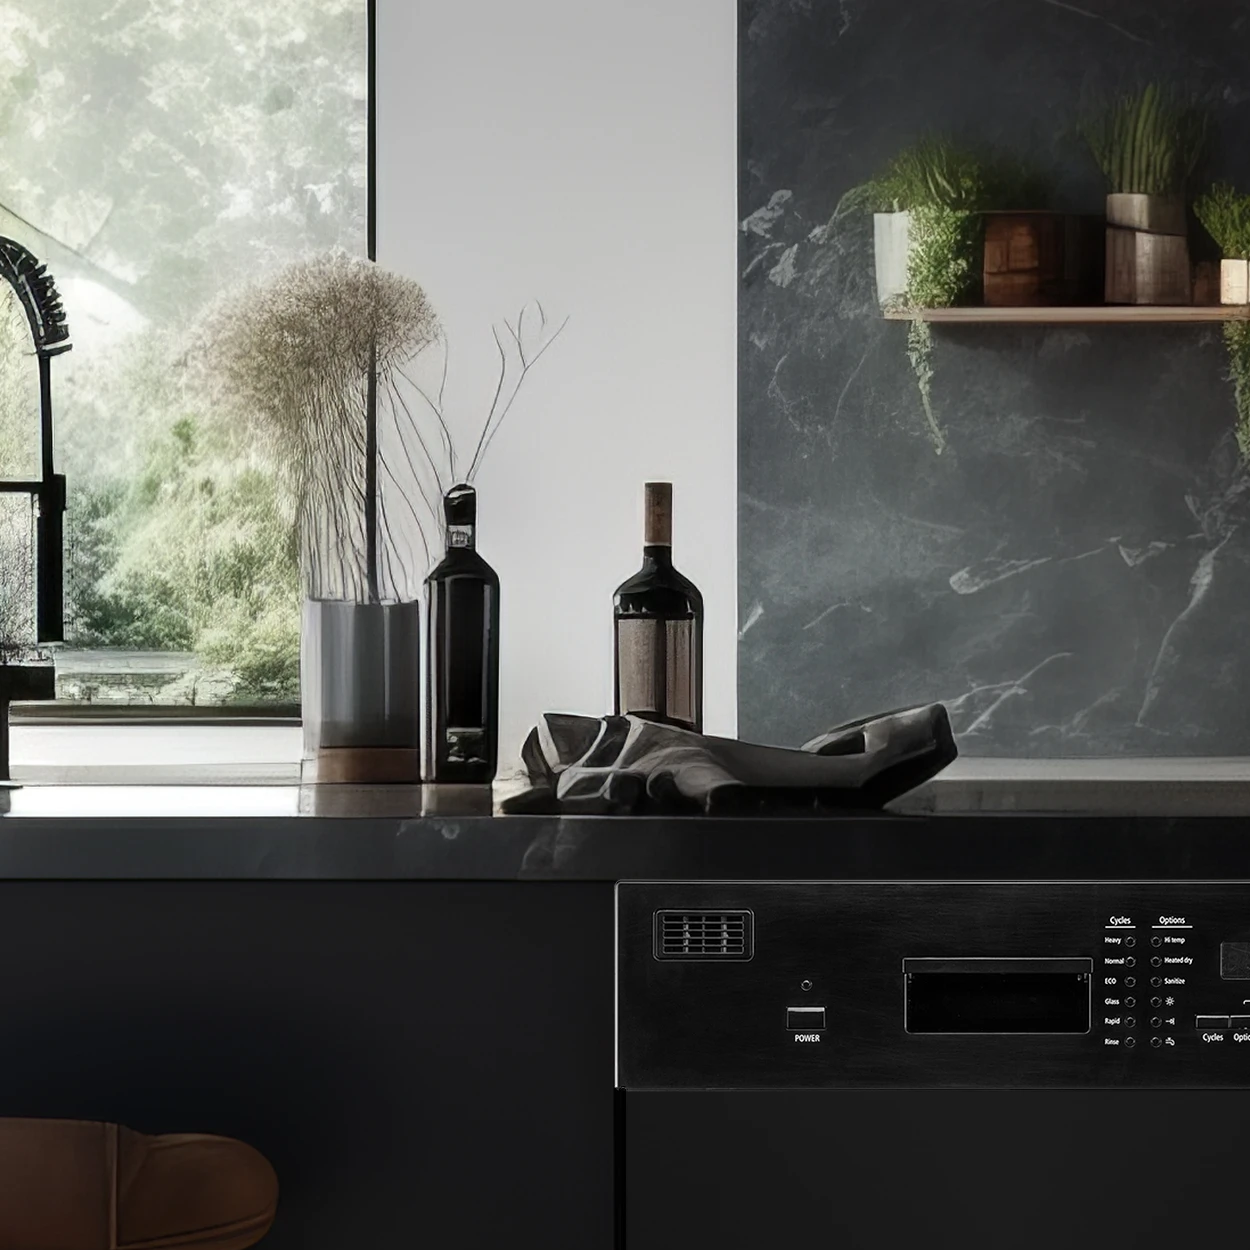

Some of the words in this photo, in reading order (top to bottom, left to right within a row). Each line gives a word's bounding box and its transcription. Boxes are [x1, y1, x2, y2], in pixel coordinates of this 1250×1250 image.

[1109, 916, 1131, 926] Cycles
[1159, 916, 1186, 925] Options
[1104, 936, 1121, 945] Heavy
[1104, 957, 1125, 965] Normal
[1184, 957, 1194, 965] dry
[1104, 977, 1117, 985] ECO
[1164, 977, 1186, 985] Sanitize
[1104, 1017, 1121, 1026] Rapid
[794, 1034, 821, 1043] POWER
[1104, 1038, 1120, 1046] Rinse
[1202, 1033, 1224, 1043] Cycles
